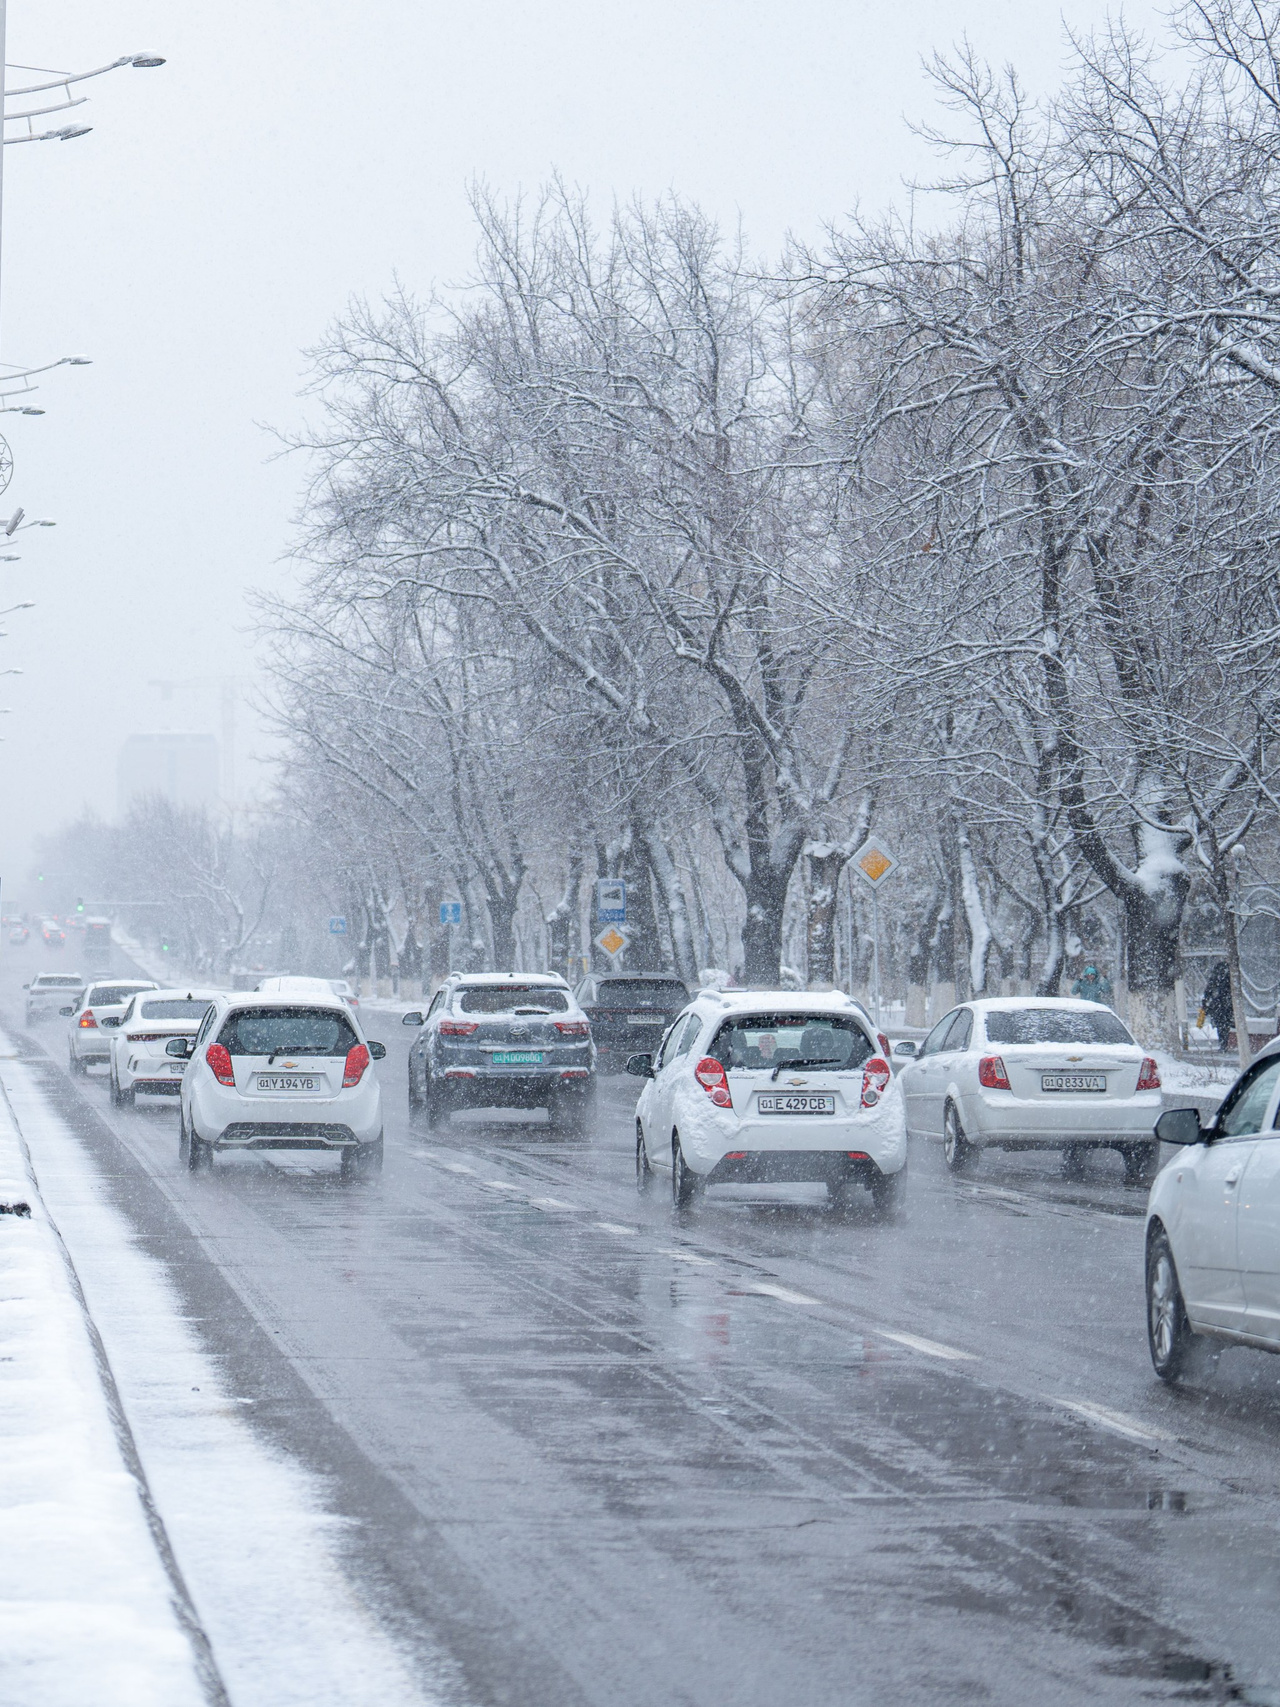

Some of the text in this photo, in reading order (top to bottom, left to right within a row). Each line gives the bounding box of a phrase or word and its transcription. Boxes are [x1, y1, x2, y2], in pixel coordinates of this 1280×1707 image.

[260, 1080, 269, 1088] 01
[281, 1079, 298, 1089] 194
[762, 1098, 826, 1110] 01 E 429 CB
